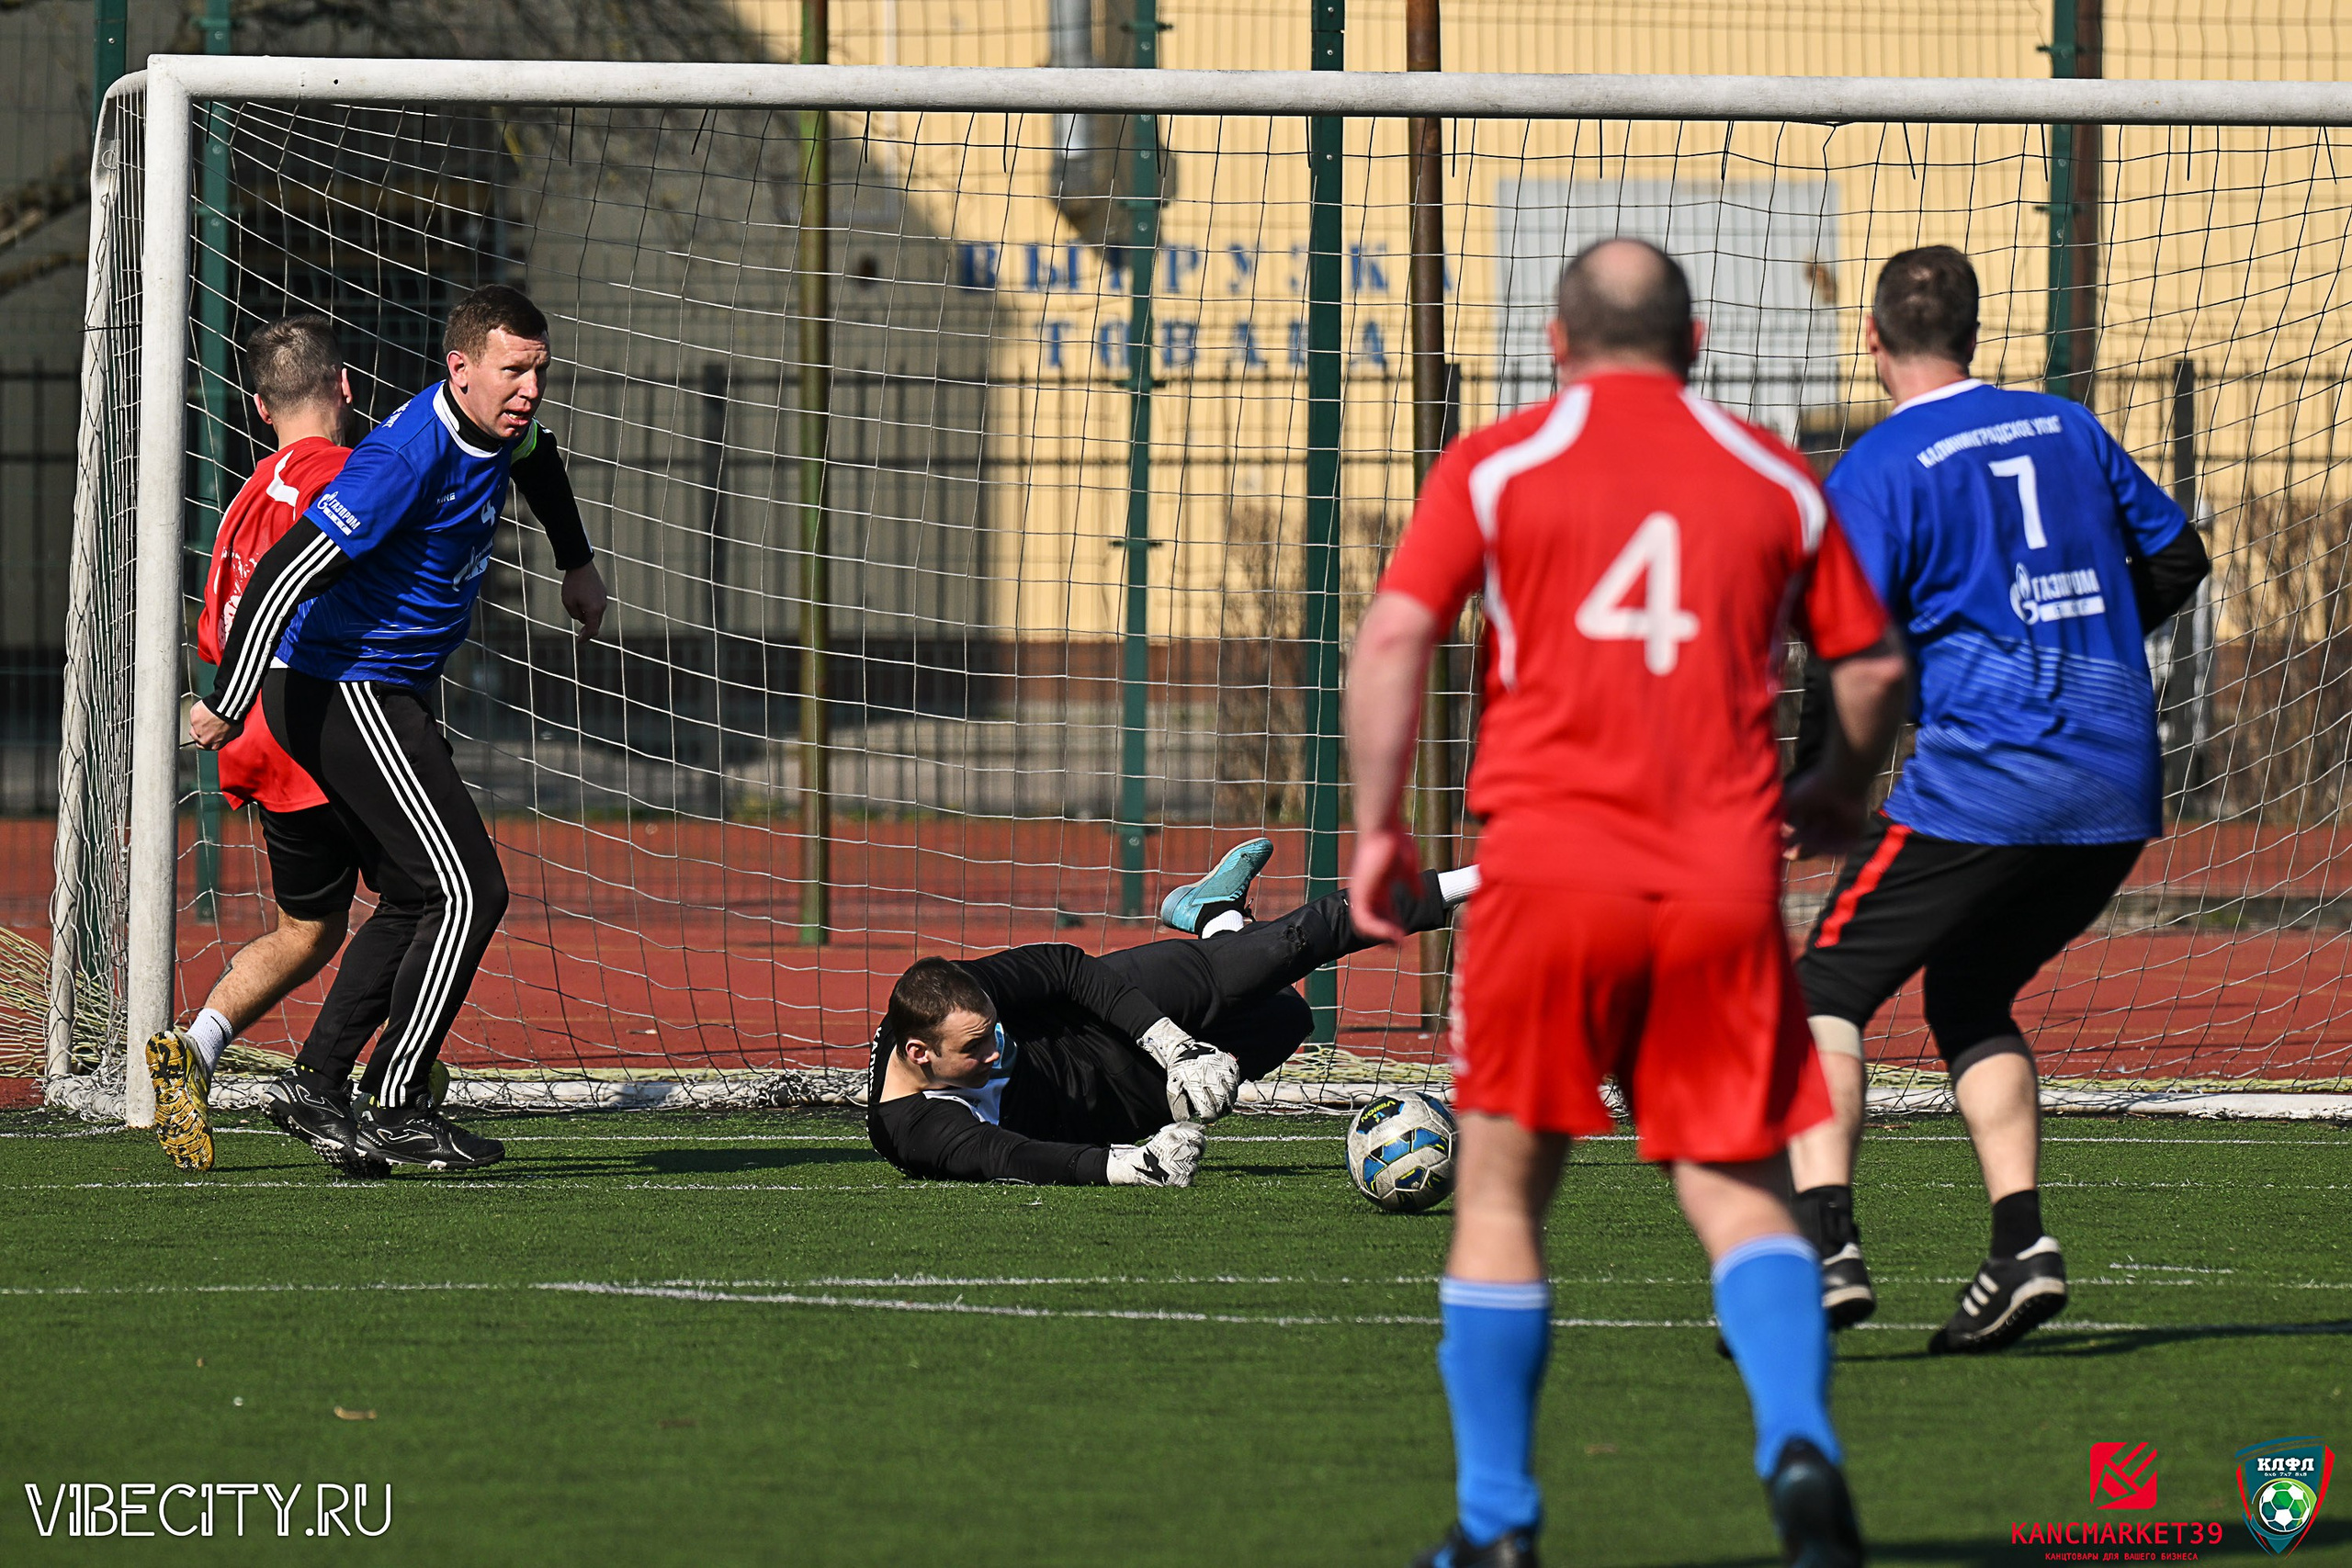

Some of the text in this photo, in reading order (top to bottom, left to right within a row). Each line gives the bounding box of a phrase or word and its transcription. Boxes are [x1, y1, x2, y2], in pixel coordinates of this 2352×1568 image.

[958, 243, 1452, 295] ВЫГРУК
[328, 499, 361, 530] ГАЗПРОМ
[481, 500, 496, 527] 4
[1988, 455, 2047, 549] 7
[1575, 511, 1701, 677] 4
[1361, 1100, 1396, 1122] VISION
